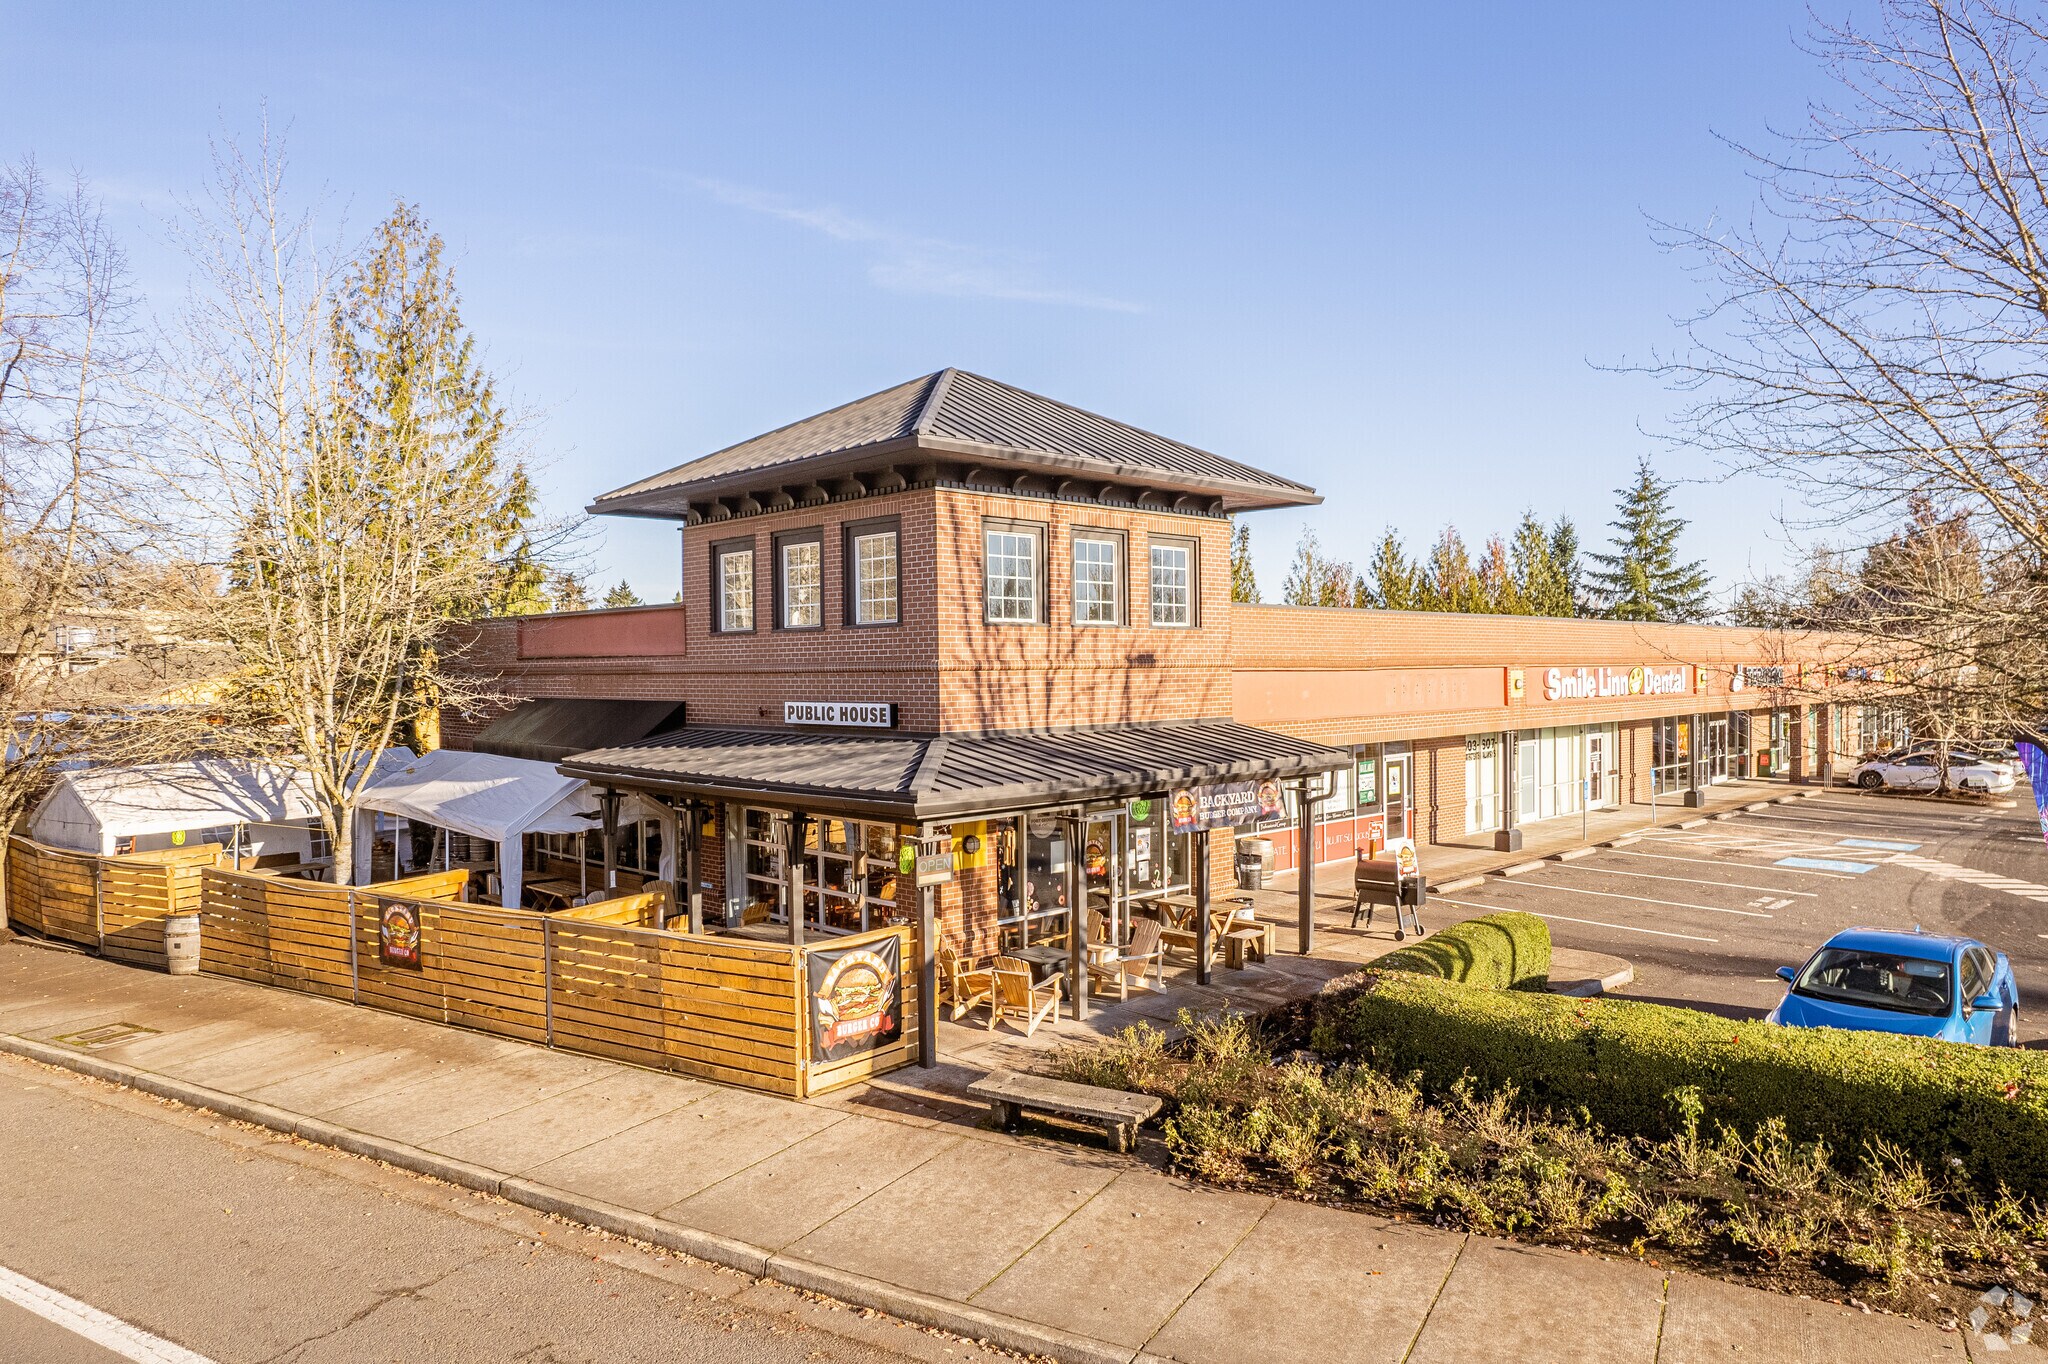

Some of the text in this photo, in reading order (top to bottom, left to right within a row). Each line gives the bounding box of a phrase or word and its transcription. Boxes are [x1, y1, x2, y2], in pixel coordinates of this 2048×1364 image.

[1547, 666, 1686, 700] Smile Linn Dental
[787, 705, 887, 723] PUBLIC HOUSE
[1199, 791, 1255, 809] BACKYARD
[1226, 805, 1258, 817] COMPANY
[918, 857, 951, 873] OPEN
[824, 951, 887, 986] BACKYARD
[836, 1016, 881, 1037] BURGER CO
